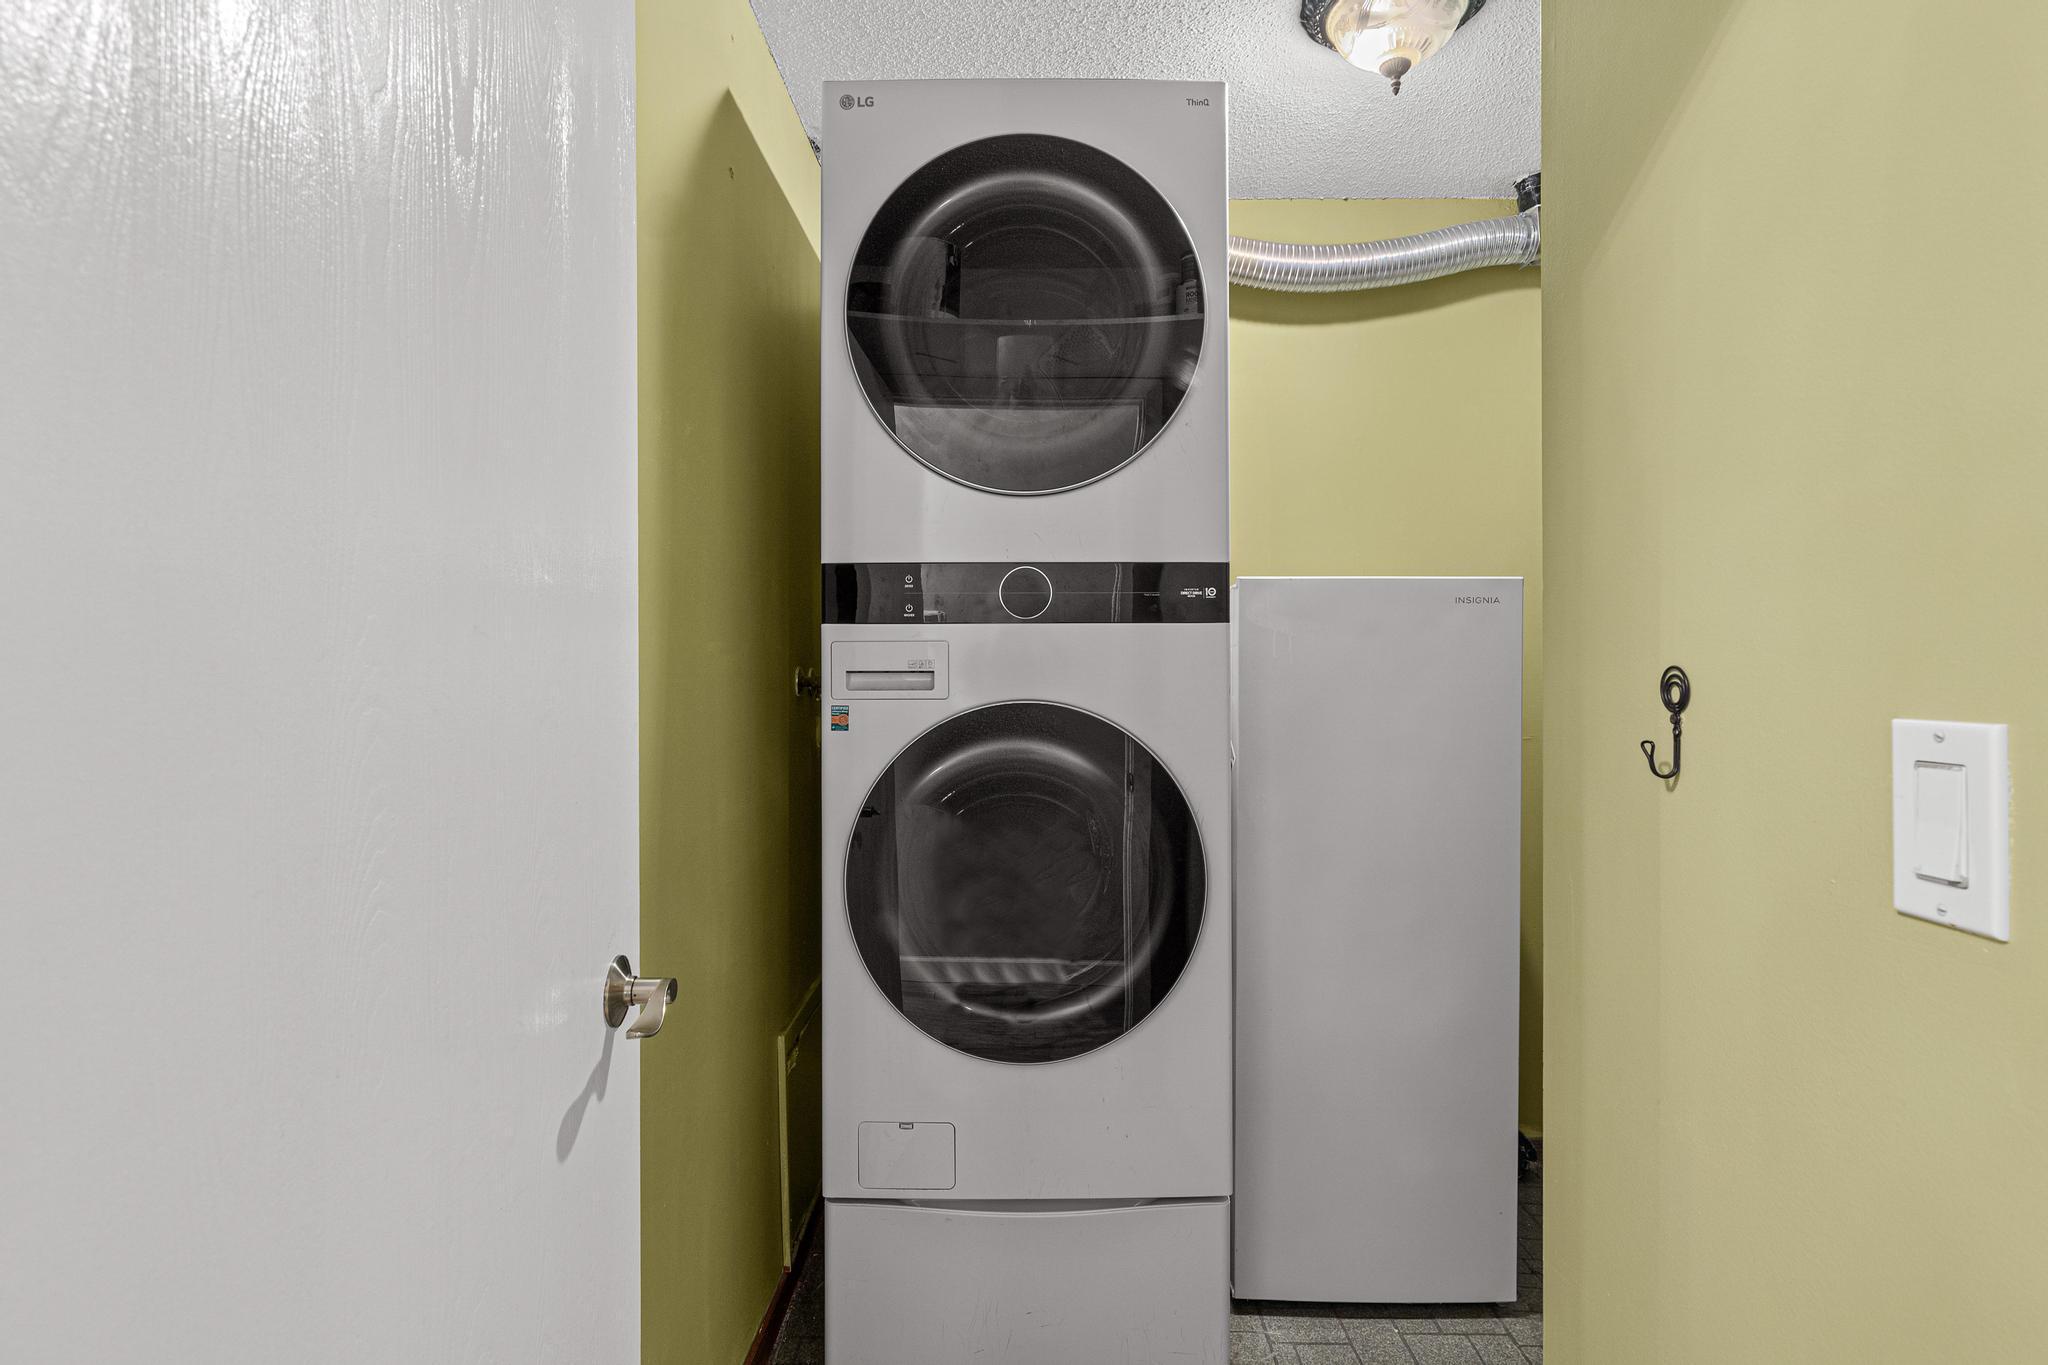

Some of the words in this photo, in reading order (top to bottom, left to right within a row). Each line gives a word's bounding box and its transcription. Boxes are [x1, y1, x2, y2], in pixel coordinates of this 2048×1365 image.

[857, 96, 874, 107] LG
[1185, 98, 1210, 106] ThinQ
[1455, 596, 1501, 604] INSIGNIA
